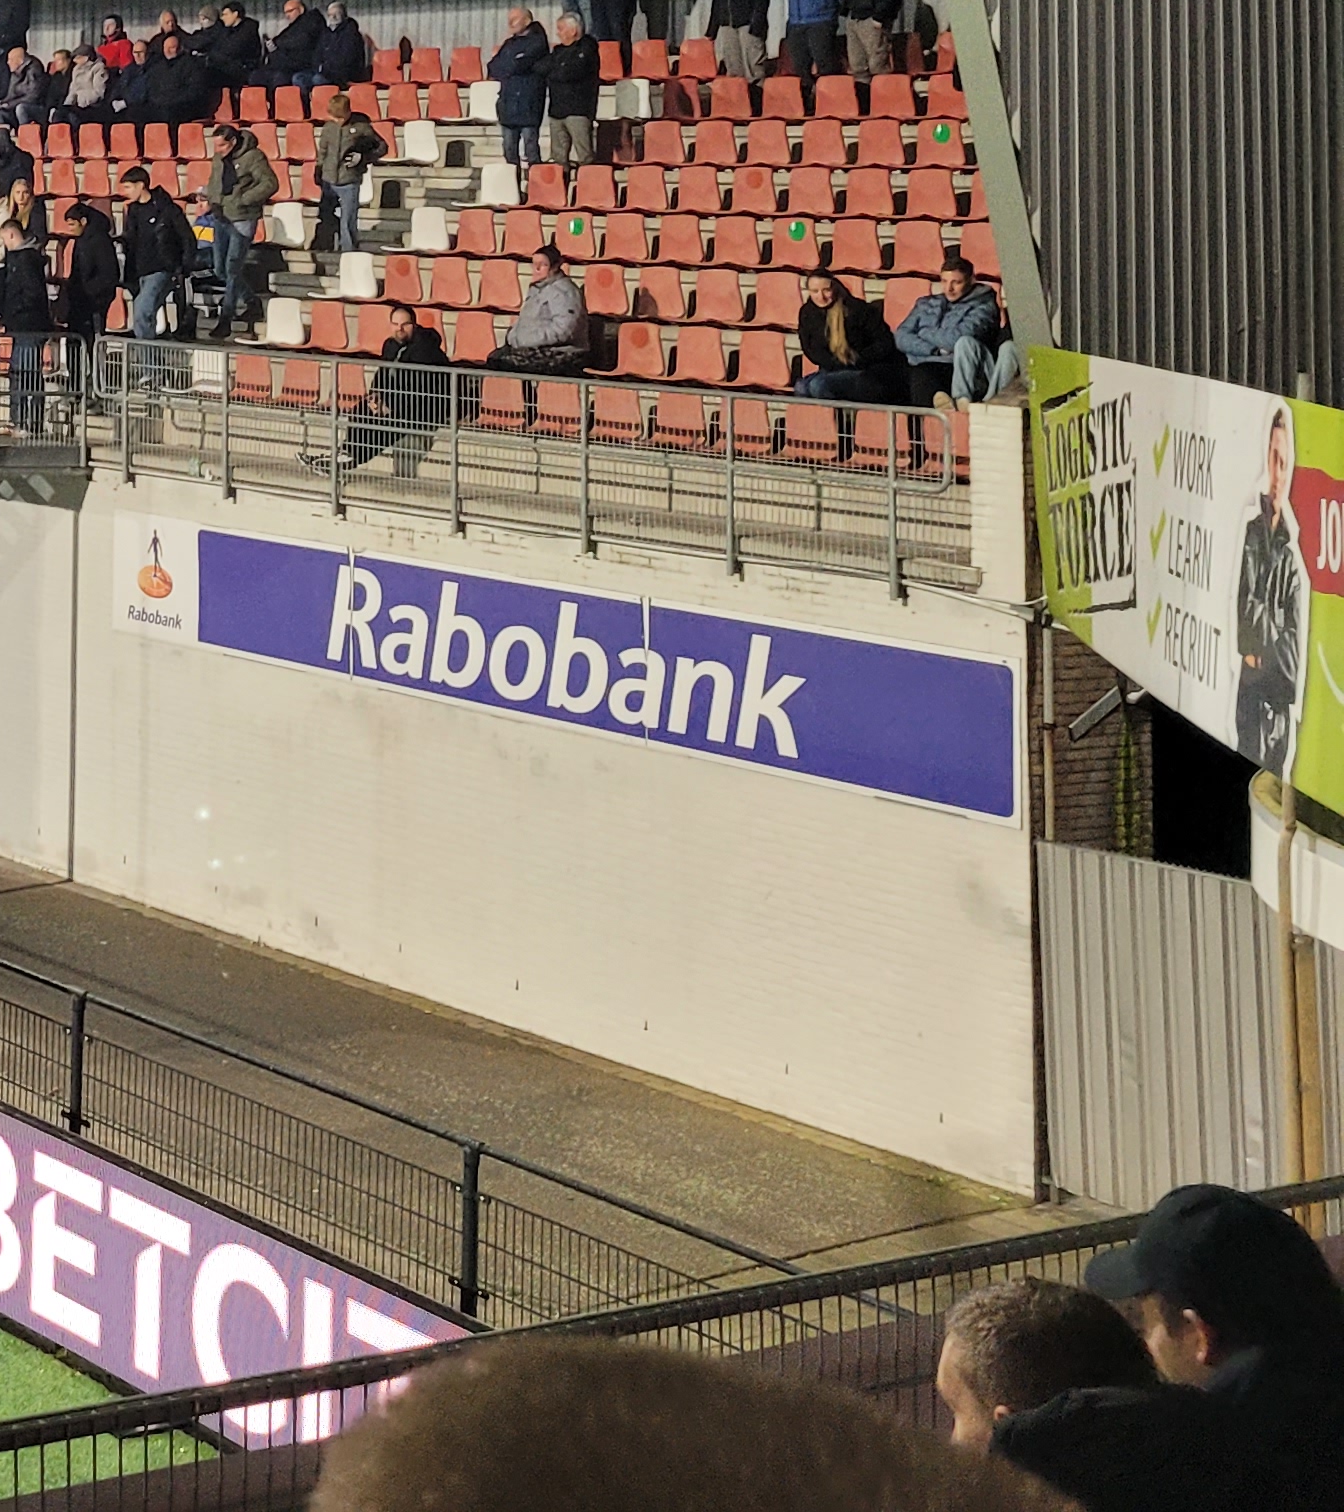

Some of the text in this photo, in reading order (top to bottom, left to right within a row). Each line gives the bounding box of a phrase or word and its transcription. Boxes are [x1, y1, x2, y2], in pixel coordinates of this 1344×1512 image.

[1043, 391, 1132, 493] LOGISTIC
[1173, 428, 1216, 501] WORK
[1048, 479, 1133, 591] FORCE
[1166, 514, 1213, 592] LEARN
[1316, 497, 1344, 574] JO
[127, 604, 183, 630] Rabobank
[1163, 602, 1222, 691] RECRUIT
[325, 562, 809, 760] Rabobank
